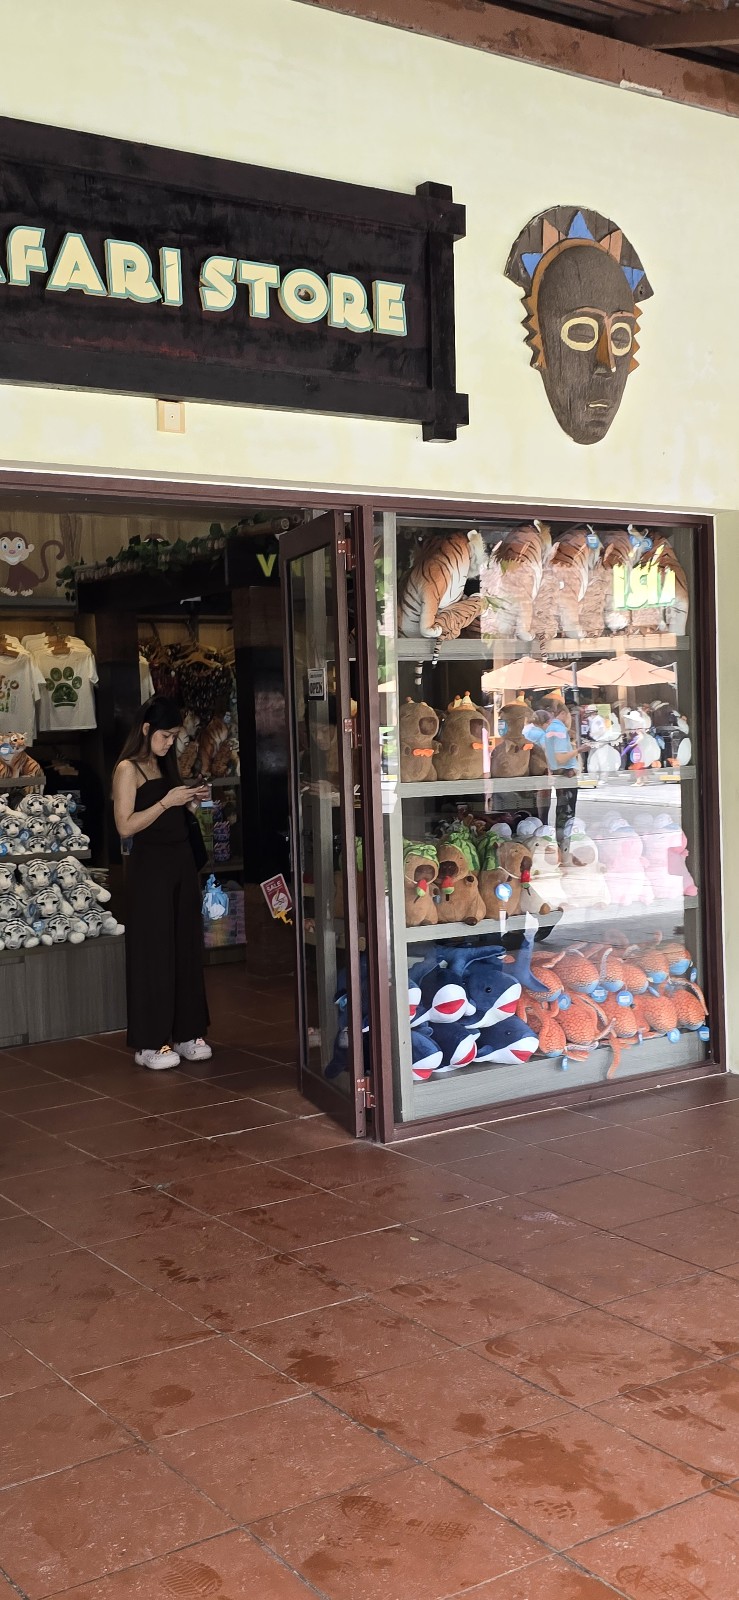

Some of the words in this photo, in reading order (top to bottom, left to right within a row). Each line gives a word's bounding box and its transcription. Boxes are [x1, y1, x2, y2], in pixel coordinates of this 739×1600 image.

[0, 225, 183, 307] FARI
[199, 255, 407, 336] STORE
[309, 682, 323, 694] OPEN
[266, 880, 282, 892] SALE
